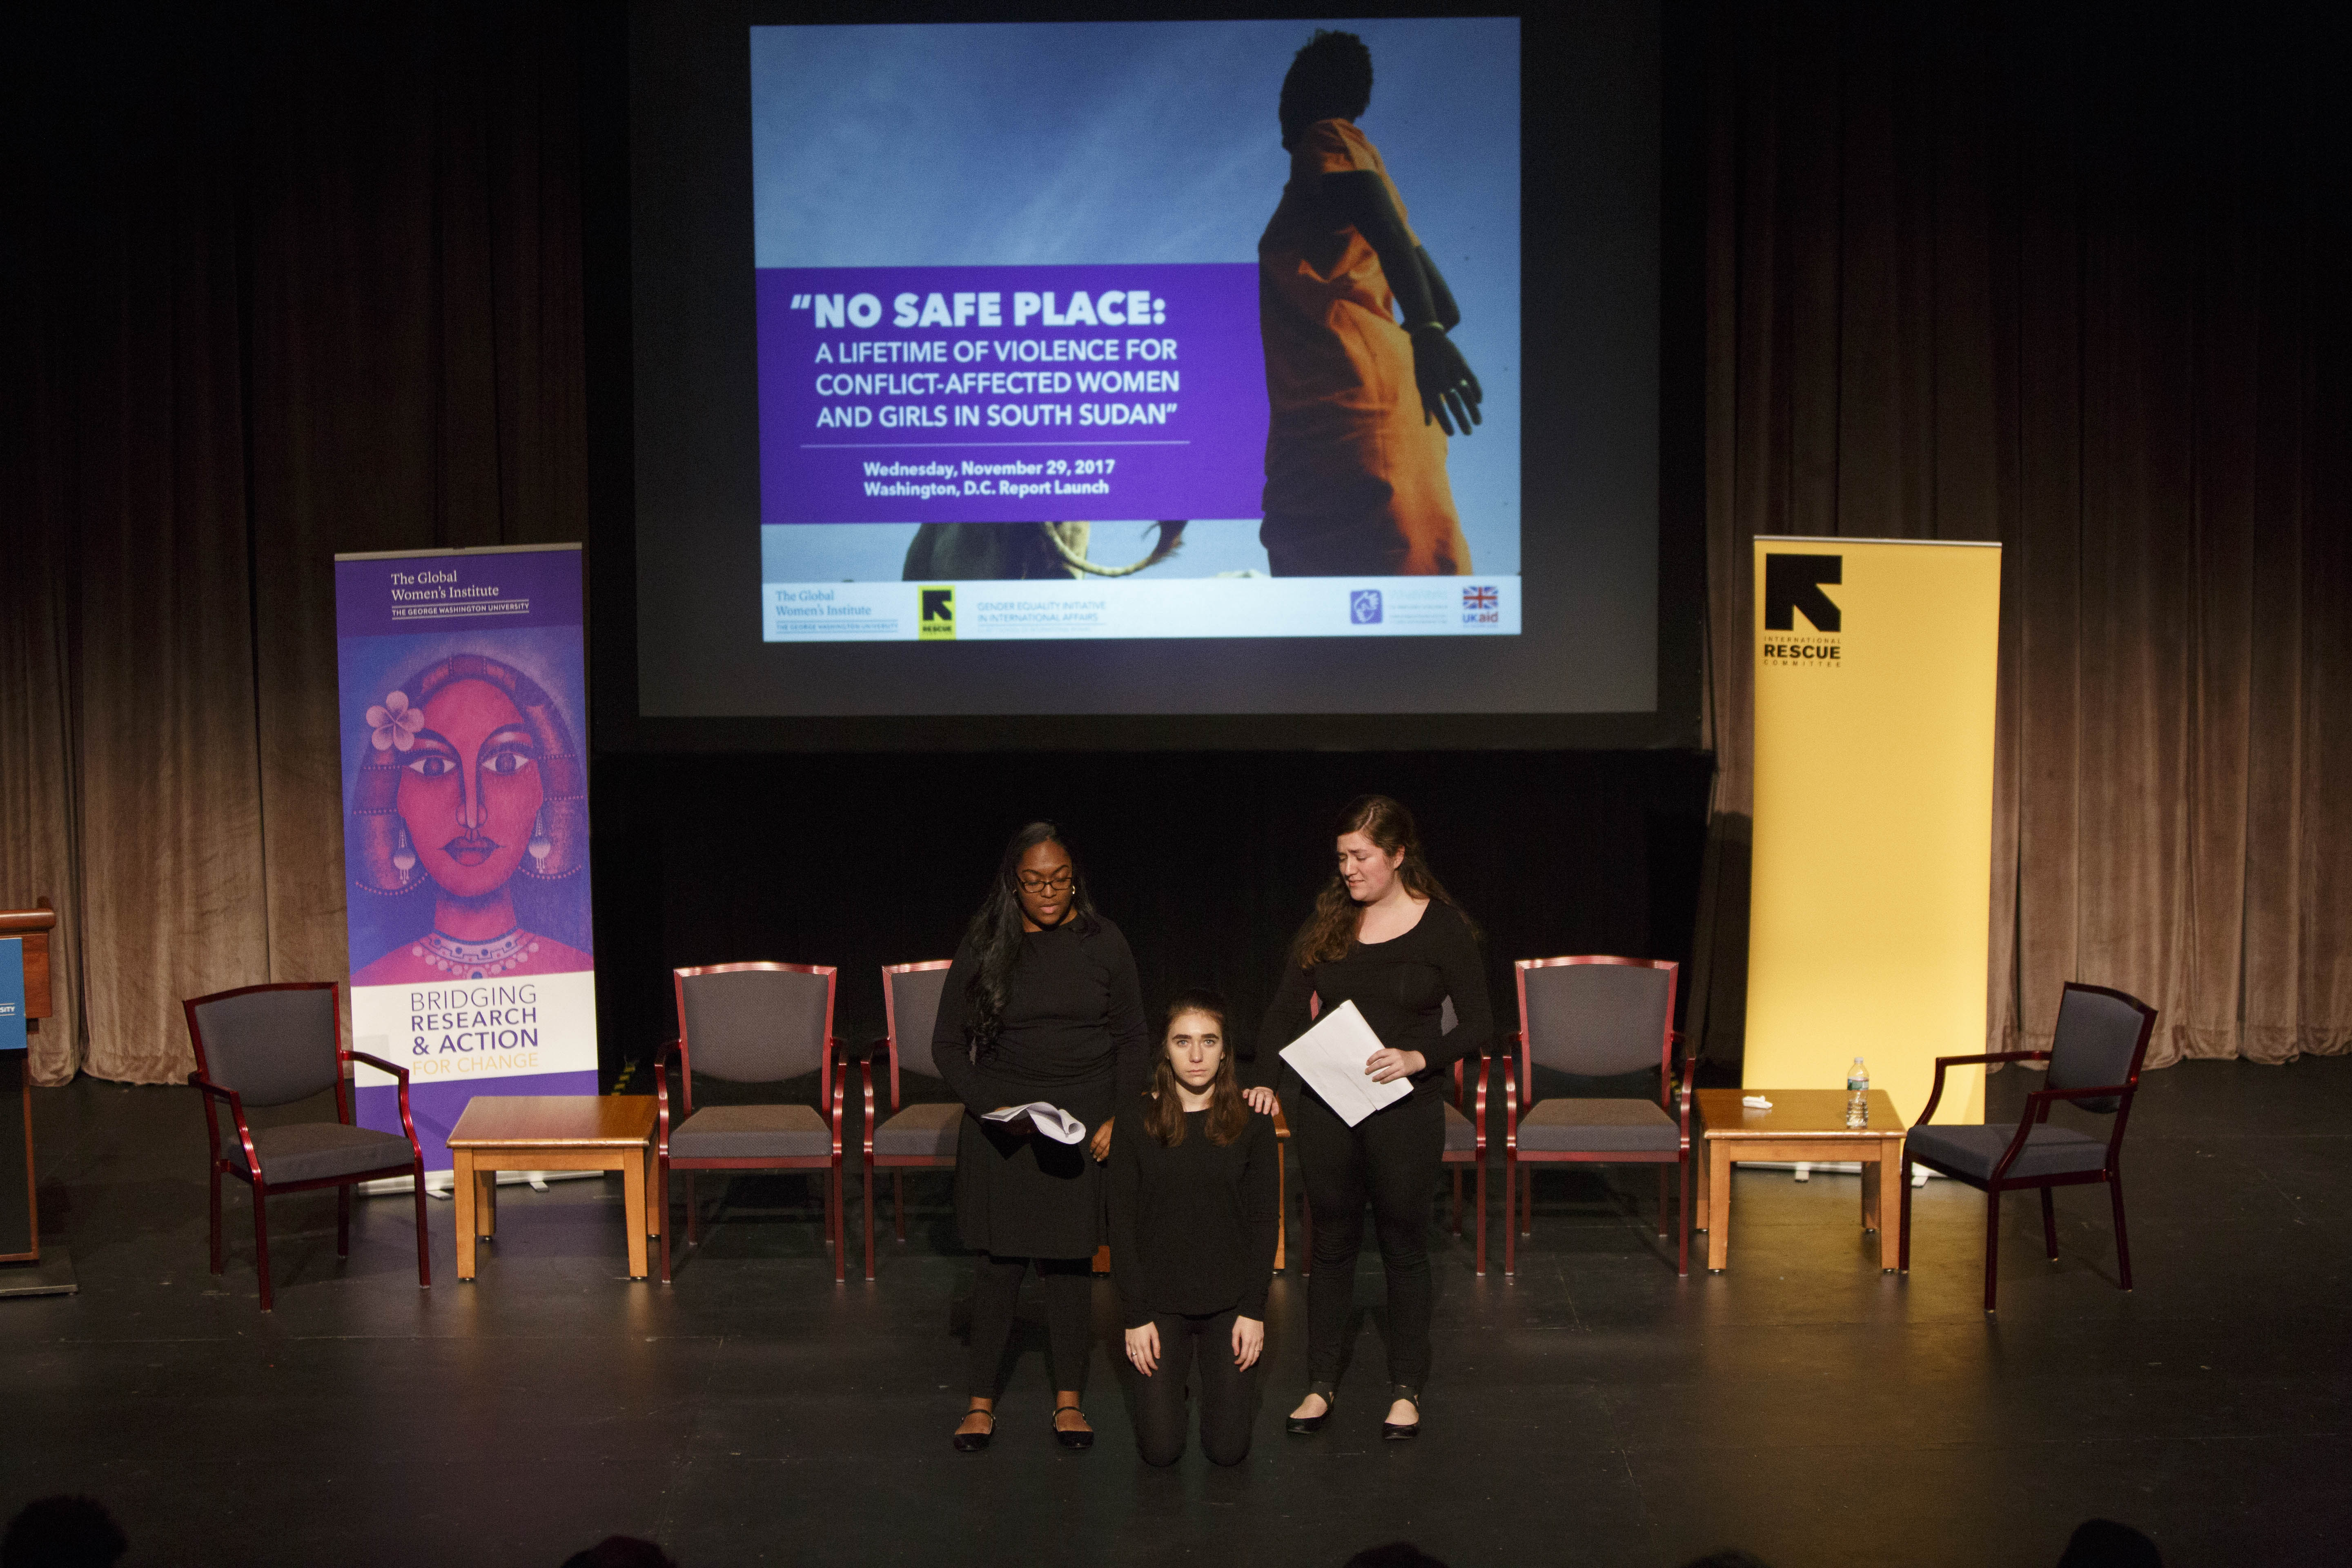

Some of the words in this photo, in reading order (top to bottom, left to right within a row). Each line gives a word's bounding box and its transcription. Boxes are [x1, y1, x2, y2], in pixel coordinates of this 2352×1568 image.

[894, 292, 1001, 327] SAFE
[1014, 290, 1165, 325] PLACE:
[815, 343, 833, 363] A
[840, 341, 947, 362] LIFETIME
[953, 341, 989, 362] OF
[994, 339, 1119, 361] VIOLENCE
[1126, 339, 1176, 360] FOR
[816, 372, 1071, 395] CONFLICT-AFFECTED
[1077, 371, 1179, 393] WOMEN
[816, 407, 872, 427] AND
[879, 405, 947, 427] GIRLS
[955, 405, 979, 426] IN
[987, 404, 1071, 426] SOUTH
[864, 462, 958, 478] Wednesday,
[962, 461, 1043, 476] November
[1046, 460, 1070, 477] 29,
[1075, 459, 1115, 474] 2017
[864, 481, 960, 499] Washington,
[964, 481, 996, 495] D.C.
[1000, 481, 1051, 498] Report
[1054, 480, 1109, 494] Launch
[391, 573, 414, 585] The
[418, 570, 457, 583] Global
[392, 586, 446, 601] Women's
[450, 585, 499, 598] Institute
[776, 590, 796, 601] The
[799, 589, 834, 601] Global
[408, 607, 437, 616] GEORGE
[439, 605, 486, 614] WASHINGTON
[488, 602, 529, 612] UNIVERSITY
[827, 604, 871, 615] Institute
[977, 602, 1014, 611] GENDER
[1018, 601, 1059, 610] EQUALITY
[1062, 601, 1106, 610] INITIATIVE
[990, 613, 1060, 621] INTERNATIONAL
[1063, 612, 1098, 621] AFFAIRS
[1764, 644, 1841, 659] RESCUE
[411, 984, 536, 1011] BRIDGING
[412, 1007, 536, 1032] RESEARCH
[412, 1036, 430, 1056] &
[439, 1028, 538, 1054] ACTION
[413, 1059, 450, 1076] FOR
[458, 1052, 539, 1073] CHANGE
